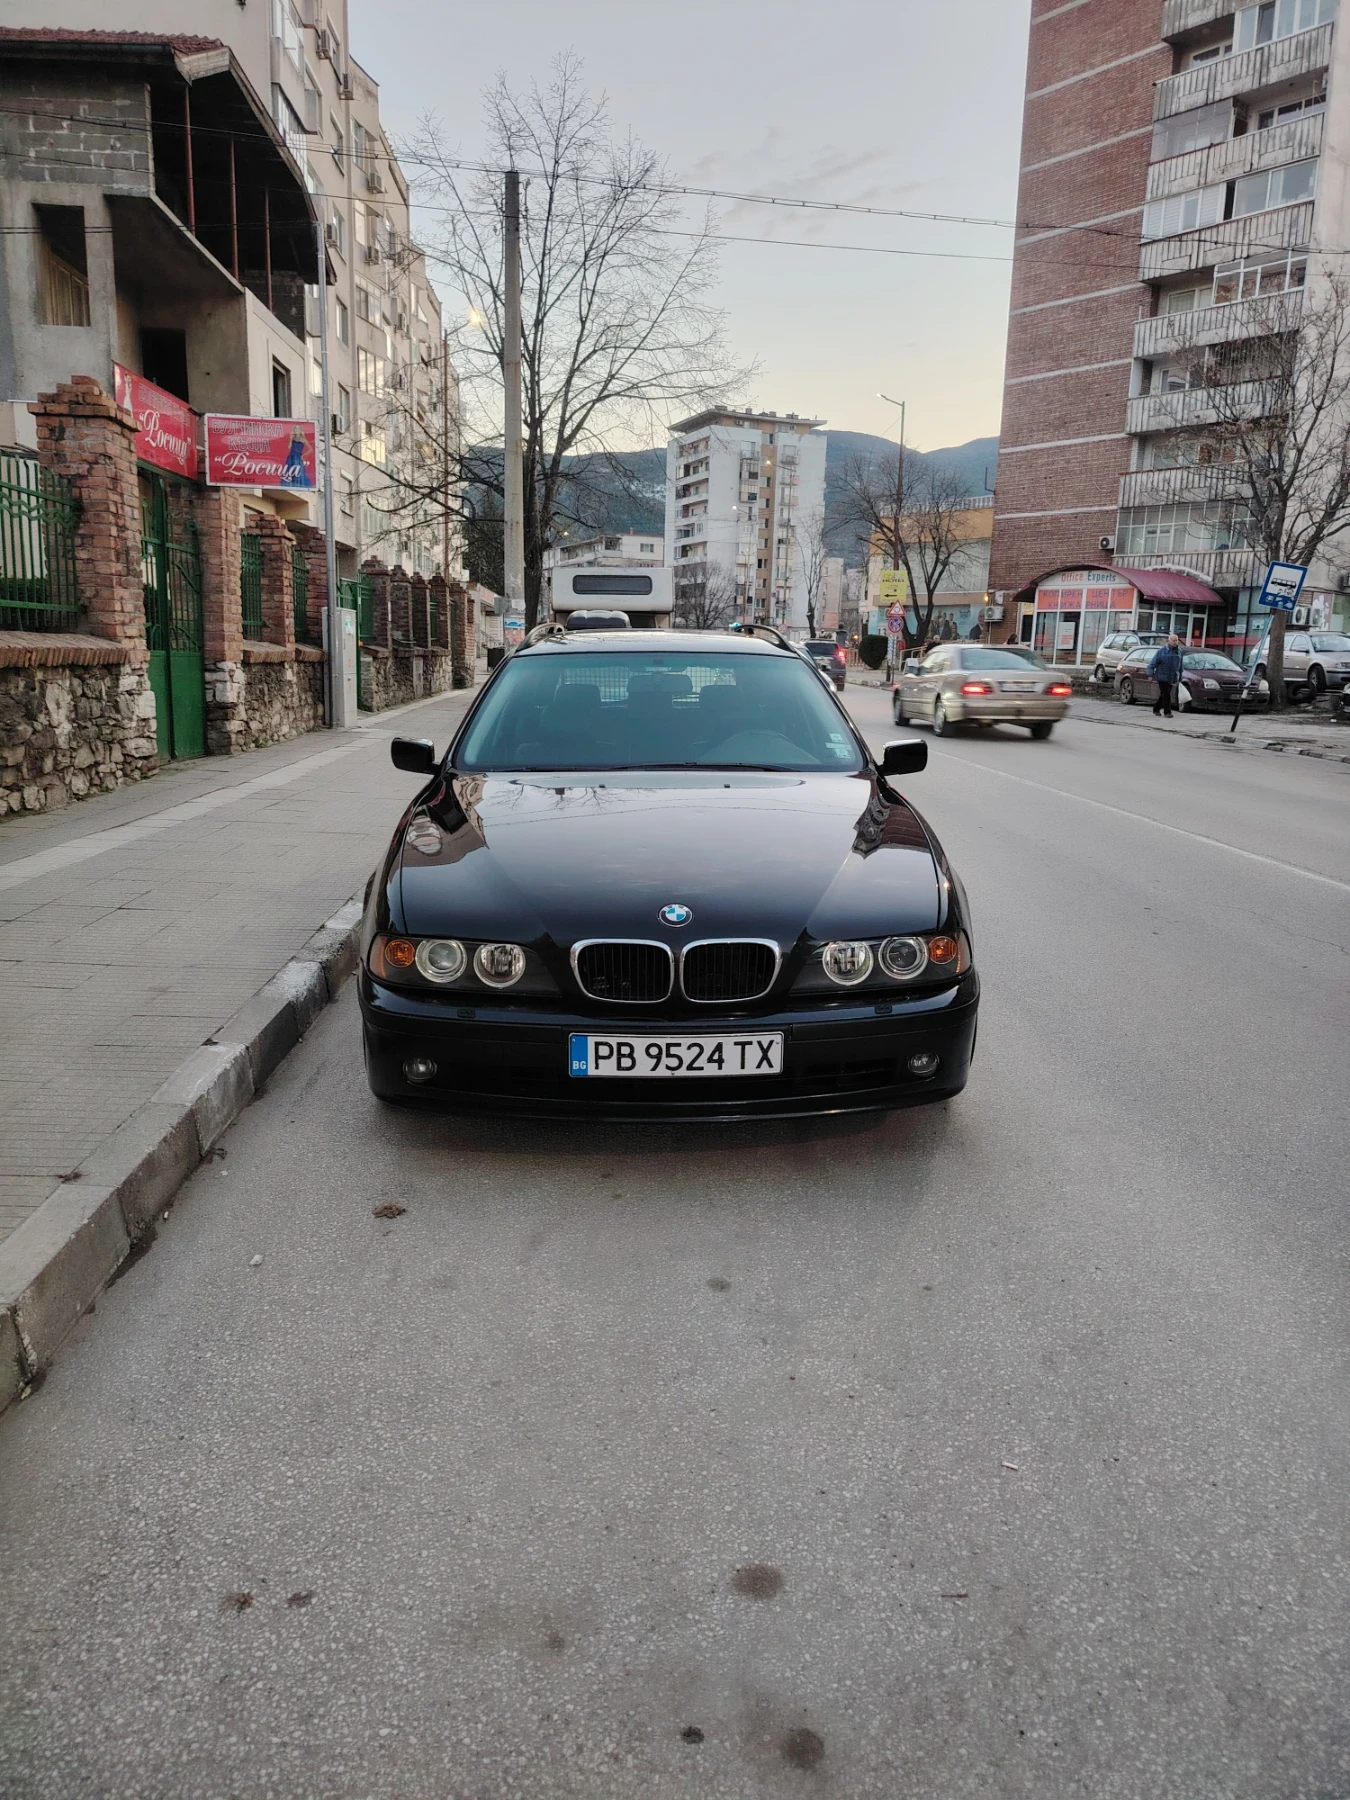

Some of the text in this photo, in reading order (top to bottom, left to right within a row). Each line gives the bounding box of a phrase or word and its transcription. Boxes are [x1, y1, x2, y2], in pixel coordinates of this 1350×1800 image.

[228, 436, 272, 454] КЪЩА
[1061, 570, 1116, 583] Office Experts
[572, 1039, 775, 1072] BG PB 9524 TX
